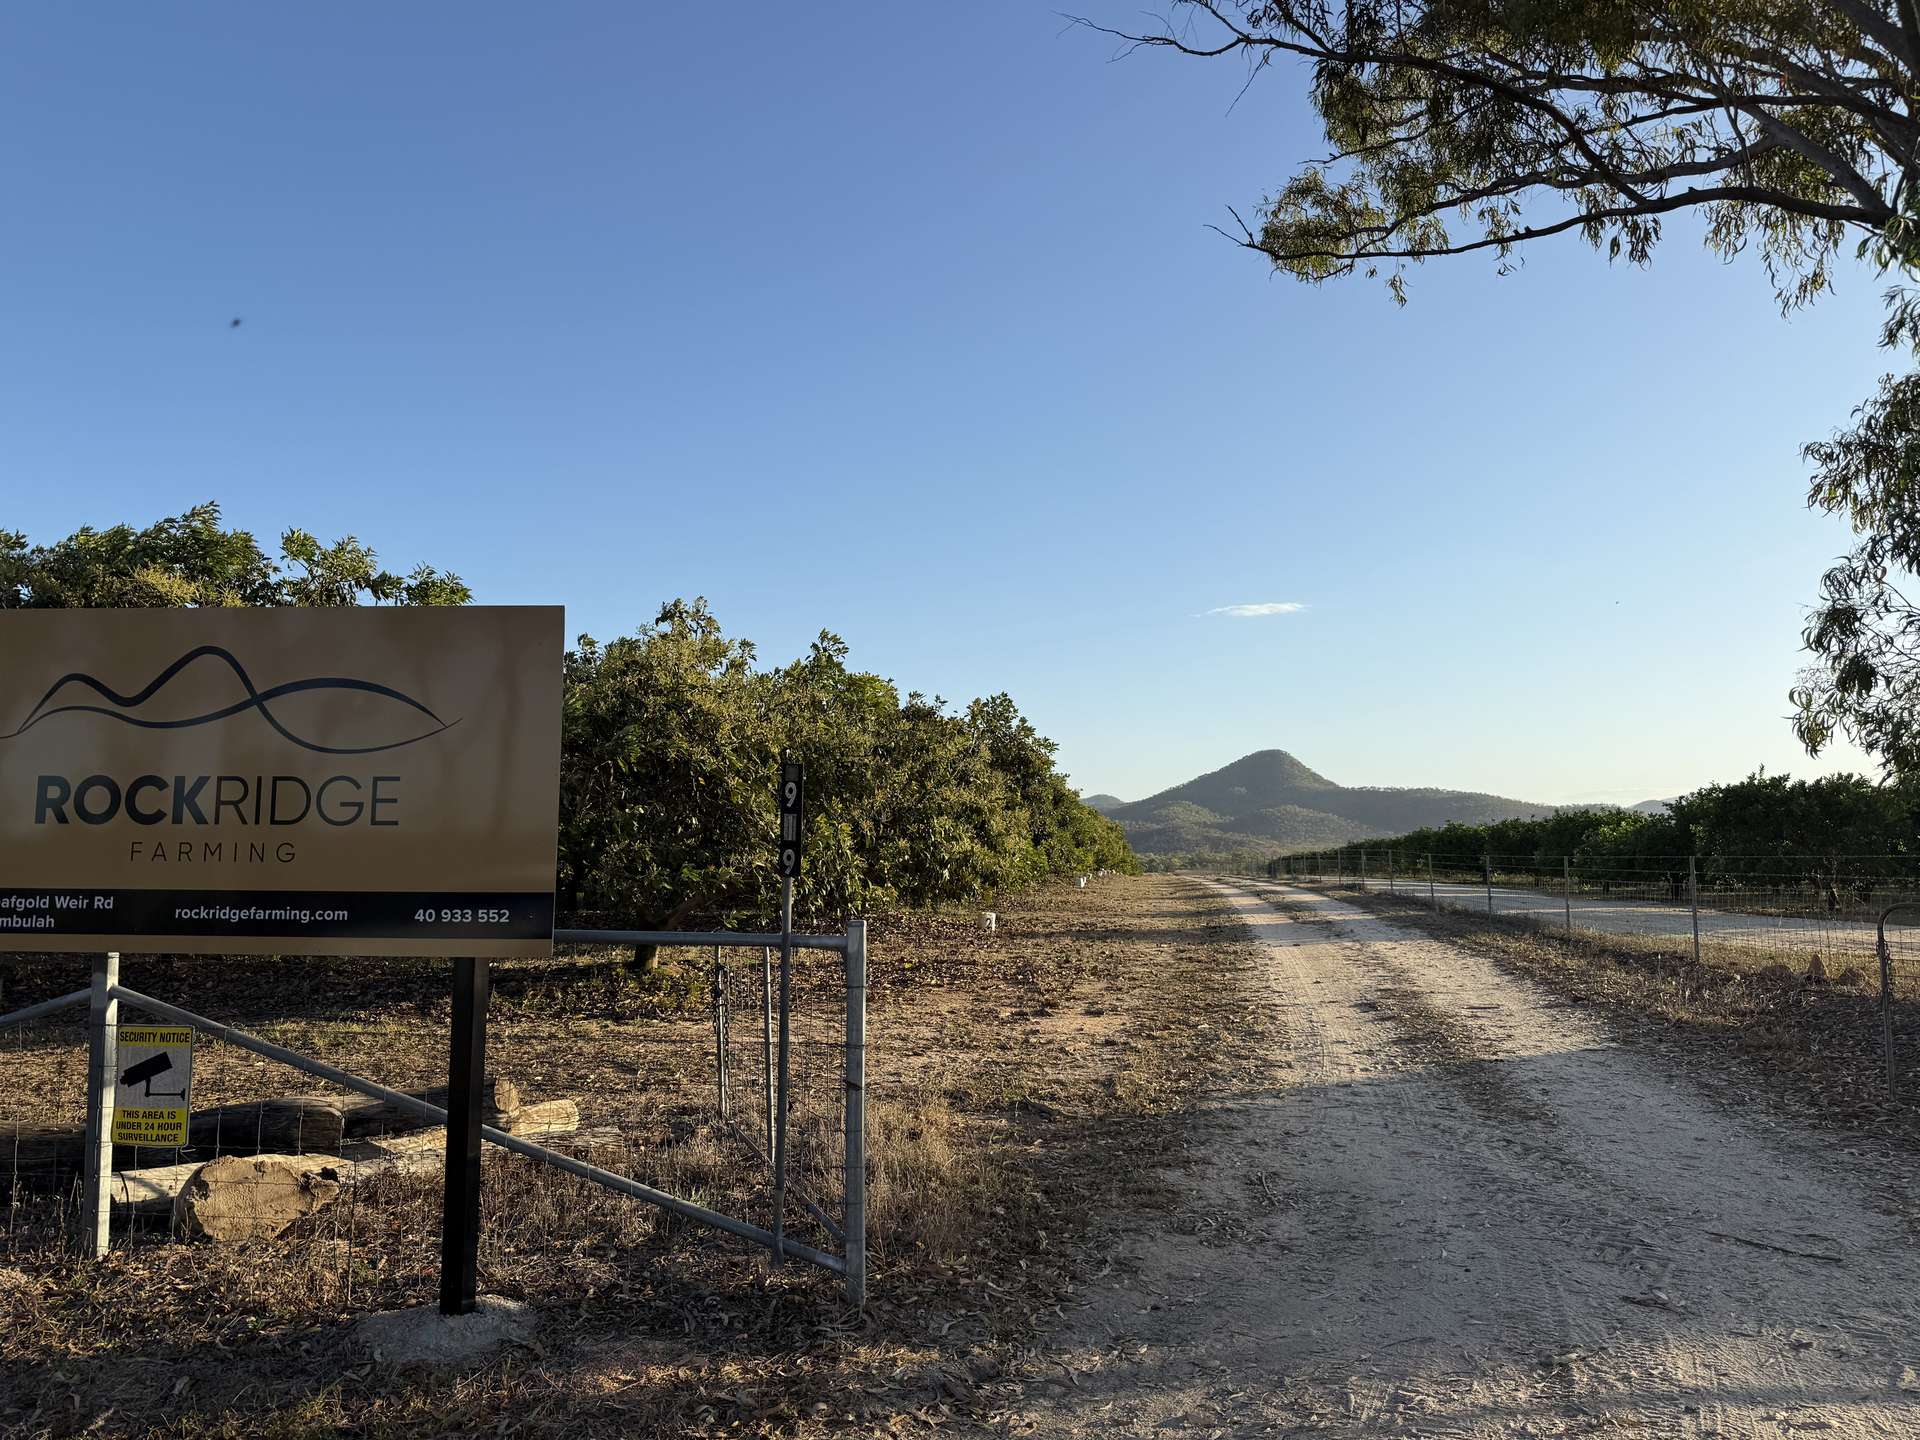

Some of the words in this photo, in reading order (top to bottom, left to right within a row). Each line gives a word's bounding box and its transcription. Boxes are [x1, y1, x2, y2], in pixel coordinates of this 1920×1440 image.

[34, 774, 400, 826] ROCKRIDGE
[130, 840, 296, 863] FARMING
[0, 895, 49, 911] afgold
[54, 895, 89, 909] Weir
[93, 896, 114, 910] Rd
[175, 905, 349, 923] rockridgefarming.com
[414, 909, 436, 922] 40
[441, 909, 472, 922] 933
[477, 909, 510, 923] 552
[119, 1031, 158, 1043] SECURITY
[160, 1031, 190, 1043] NOTICE
[122, 1109, 140, 1119] THIS
[141, 1110, 165, 1120] AREA
[167, 1110, 176, 1120] IS
[116, 1120, 142, 1130] UNDER
[144, 1121, 155, 1131] 24
[157, 1121, 182, 1131] HOUR
[117, 1131, 179, 1142] SURVEILLANCE
